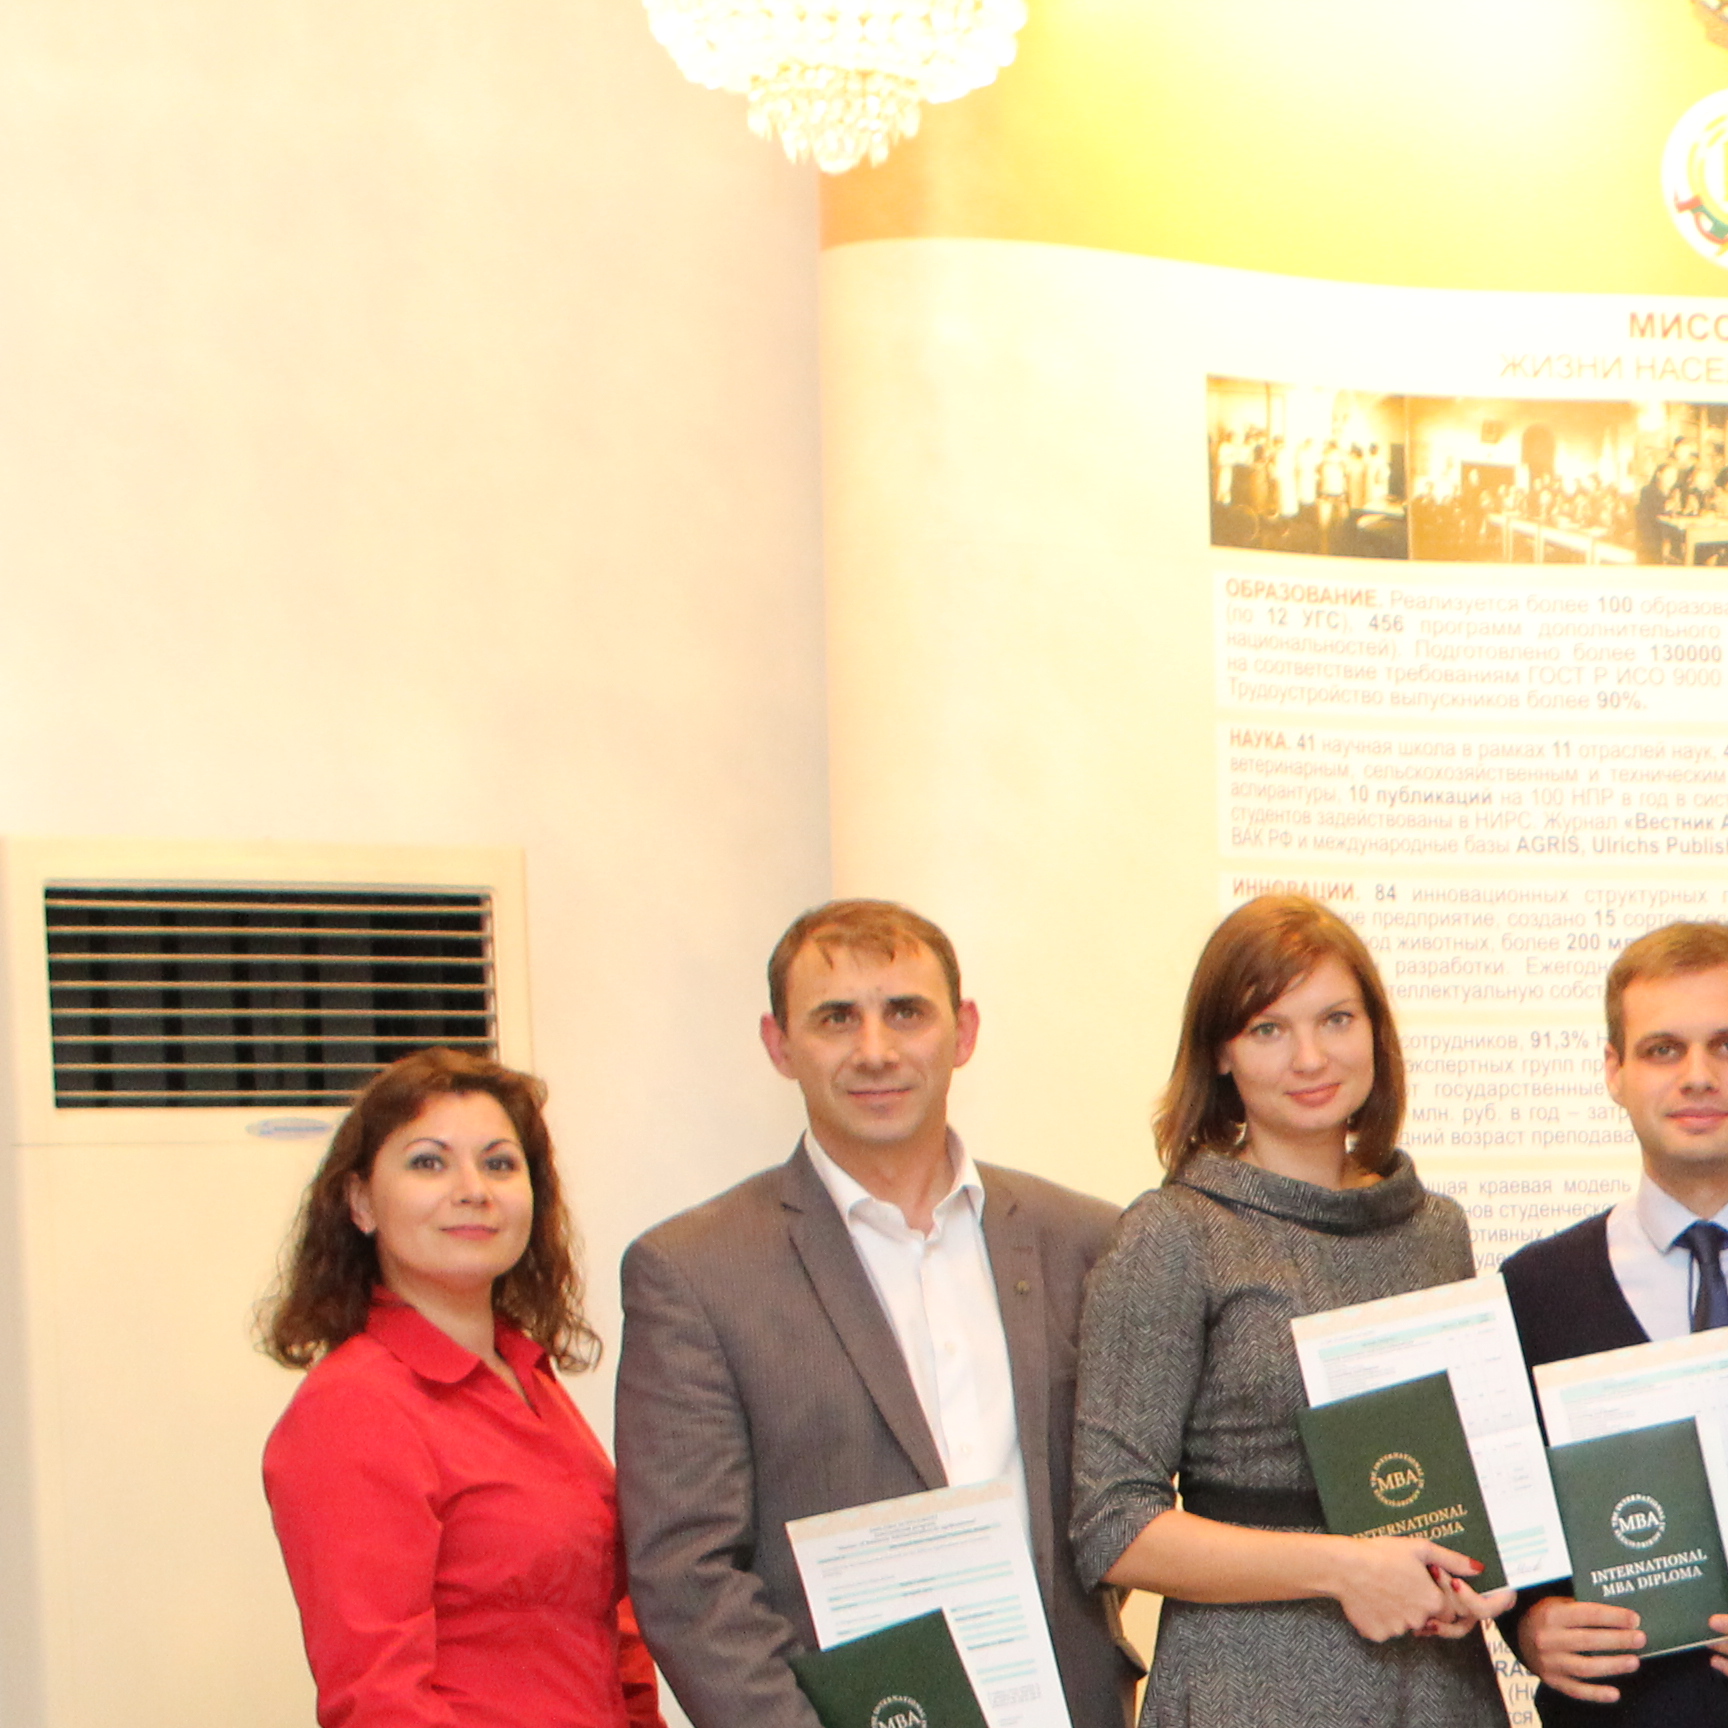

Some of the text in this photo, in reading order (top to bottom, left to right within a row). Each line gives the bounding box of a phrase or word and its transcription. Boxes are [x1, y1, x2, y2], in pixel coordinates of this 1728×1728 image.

[1500, 353, 1624, 380] ЖИЗНИ
[1597, 595, 1635, 615] 100
[1266, 606, 1289, 628] 12
[1367, 613, 1406, 635] 456
[1649, 644, 1724, 664] 130000
[1595, 690, 1649, 711] 90%.
[1228, 728, 1292, 750] НАУКА.
[1295, 734, 1317, 752] 41
[1551, 740, 1573, 759] 11
[1348, 784, 1371, 805] 10
[1375, 786, 1494, 808] публикаций
[1530, 788, 1565, 808] 100
[1623, 812, 1716, 832] «Вестник
[1514, 835, 1586, 855] AGRIS,
[1591, 836, 1661, 855] Ulrichs
[1373, 883, 1399, 905] 84
[1530, 1031, 1588, 1052] 91,3%
[1377, 1468, 1419, 1492] MBA
[1619, 1511, 1660, 1533] MBA
[1590, 1548, 1708, 1584] INTERNATIONAL
[1602, 1565, 1704, 1597] MBA DIPLOMA
